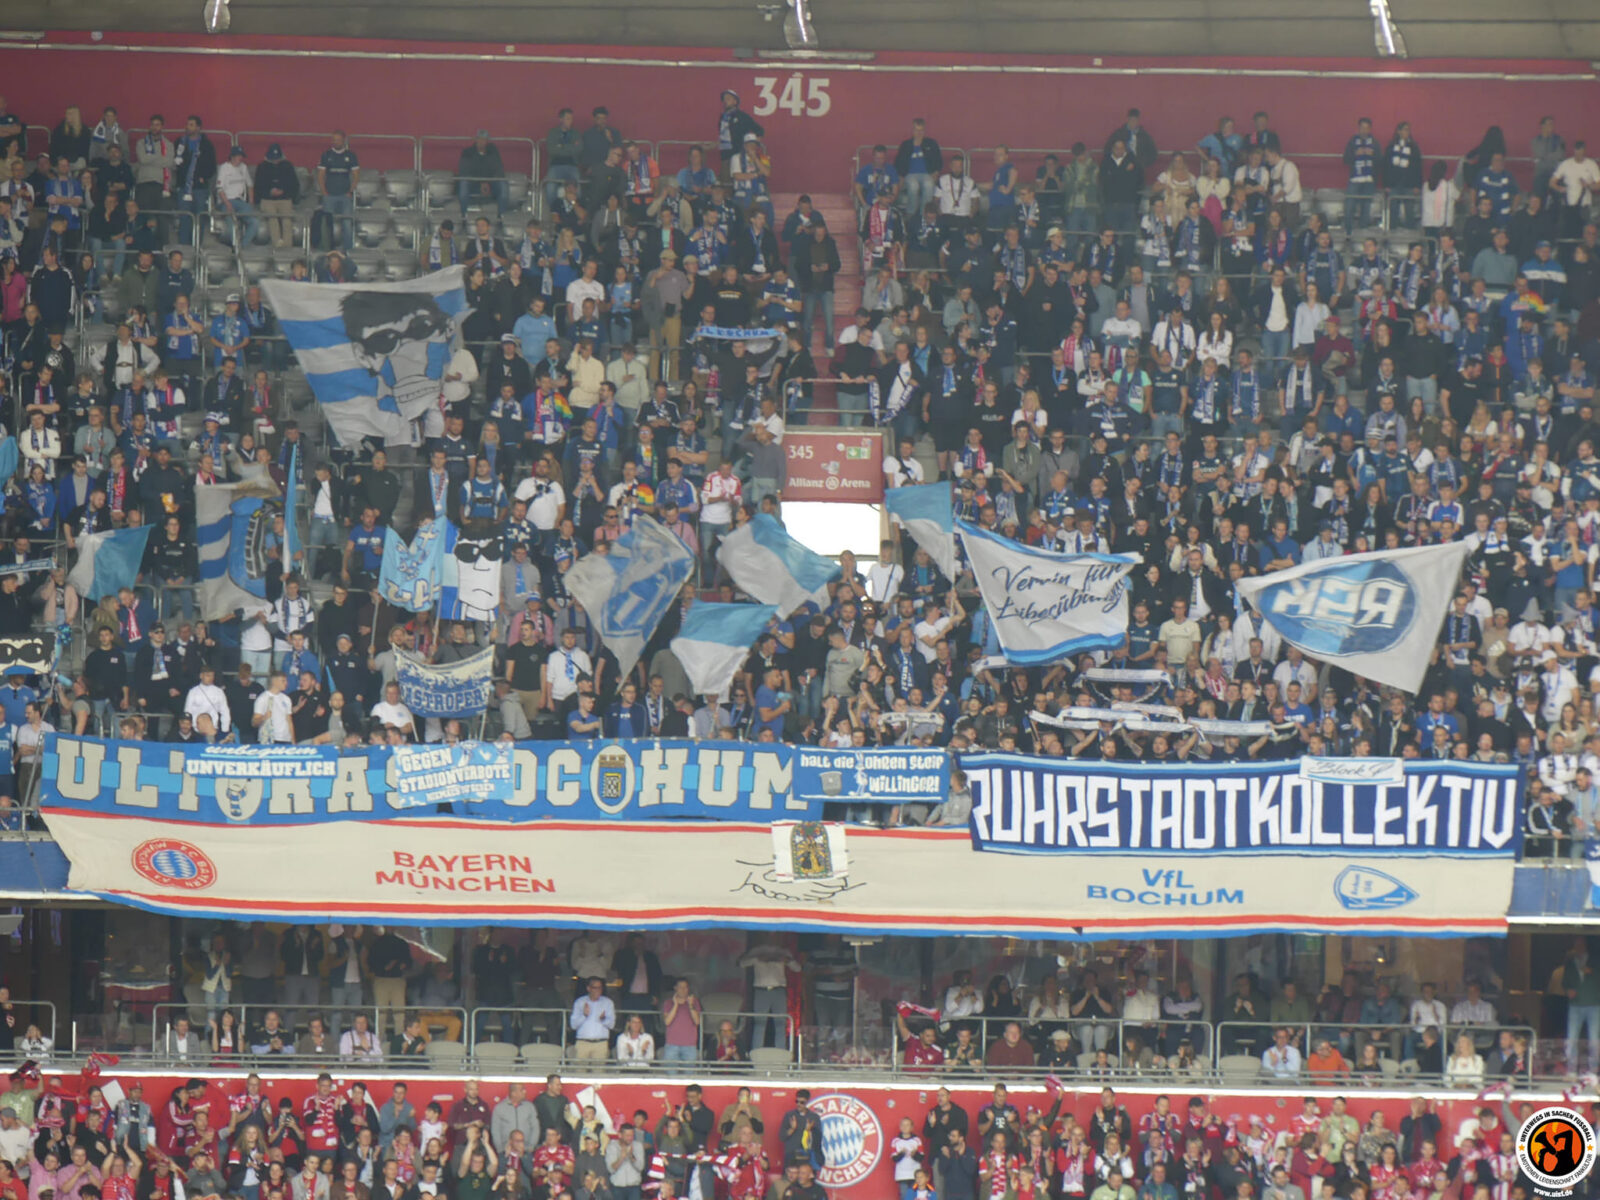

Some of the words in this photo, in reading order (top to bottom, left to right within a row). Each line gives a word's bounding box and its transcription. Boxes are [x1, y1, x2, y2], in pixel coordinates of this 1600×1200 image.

[753, 77, 831, 117] 345
[788, 445, 814, 459] 345
[788, 477, 825, 488] Allianz
[840, 478, 871, 488] Arena
[186, 759, 336, 776] UNVERKÄUFLICH
[401, 747, 453, 773] GEGEN
[834, 755, 855, 769] die
[400, 763, 511, 793] STADIONVERBOTE
[962, 768, 1517, 850] RUHRSTADTKOLLEKTIV
[393, 851, 533, 874] BAYERN
[375, 869, 556, 893] MÜNCHEN
[1142, 868, 1195, 889] VfL
[1087, 885, 1245, 906] BOCHUM
[813, 1099, 876, 1137] BAYERN
[819, 1149, 875, 1183] NCHEN
